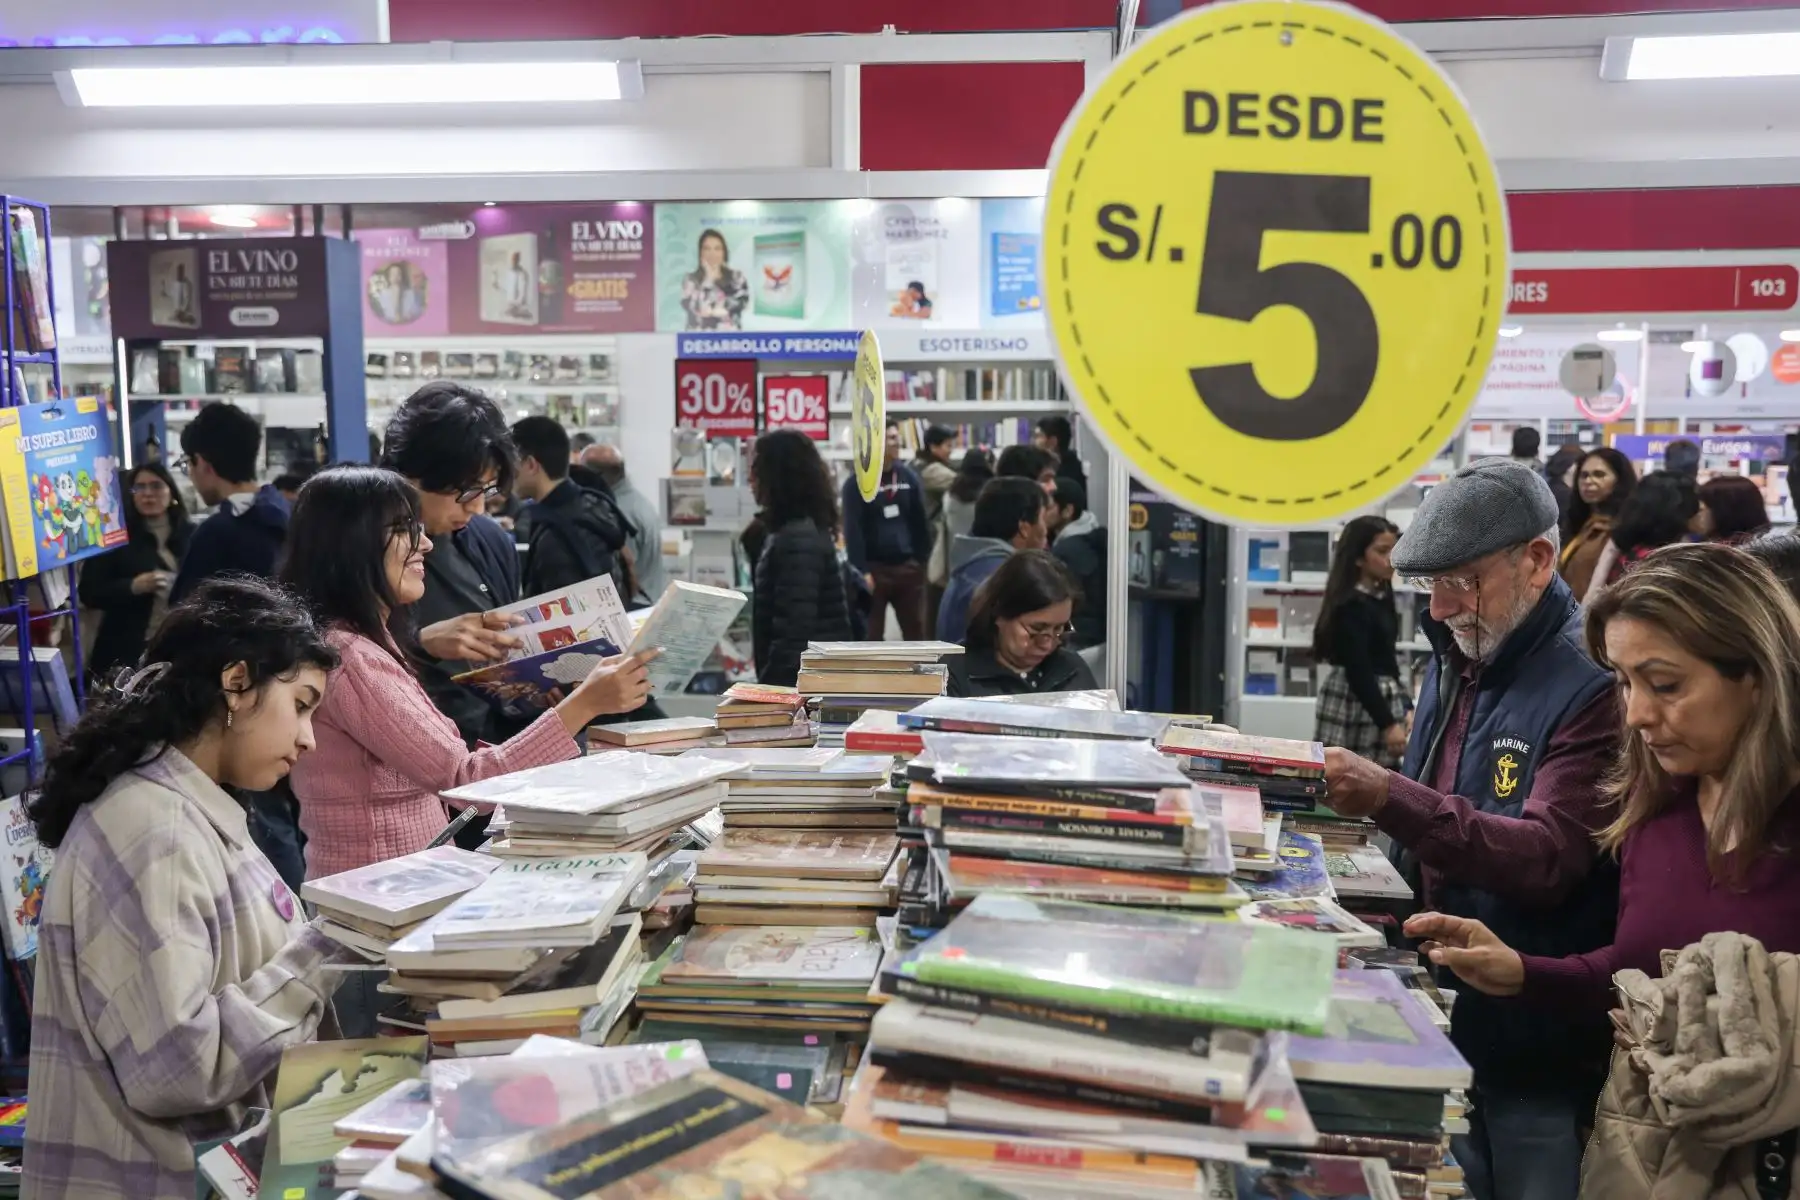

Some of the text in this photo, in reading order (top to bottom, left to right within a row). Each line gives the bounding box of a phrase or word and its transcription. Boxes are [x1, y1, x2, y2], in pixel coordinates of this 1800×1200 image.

[1182, 89, 1385, 143] DESDE
[572, 220, 643, 240] EL VINO
[209, 249, 298, 273] EL VINO
[209, 275, 227, 289] EN
[229, 275, 263, 288] SIETE
[573, 280, 628, 299] GRATIS
[1751, 279, 1786, 296] 103
[683, 339, 782, 354] DESARROLLO
[919, 337, 1029, 353] ESOTERISMO
[680, 373, 753, 415] 30%
[768, 388, 826, 421] 50%
[15, 436, 32, 454] MI
[31, 431, 67, 451] SUPER
[65, 424, 98, 444] LIBRO
[1702, 440, 1751, 457] Europa
[1493, 738, 1530, 754] MARINE
[1058, 822, 1116, 838] ROBINSON
